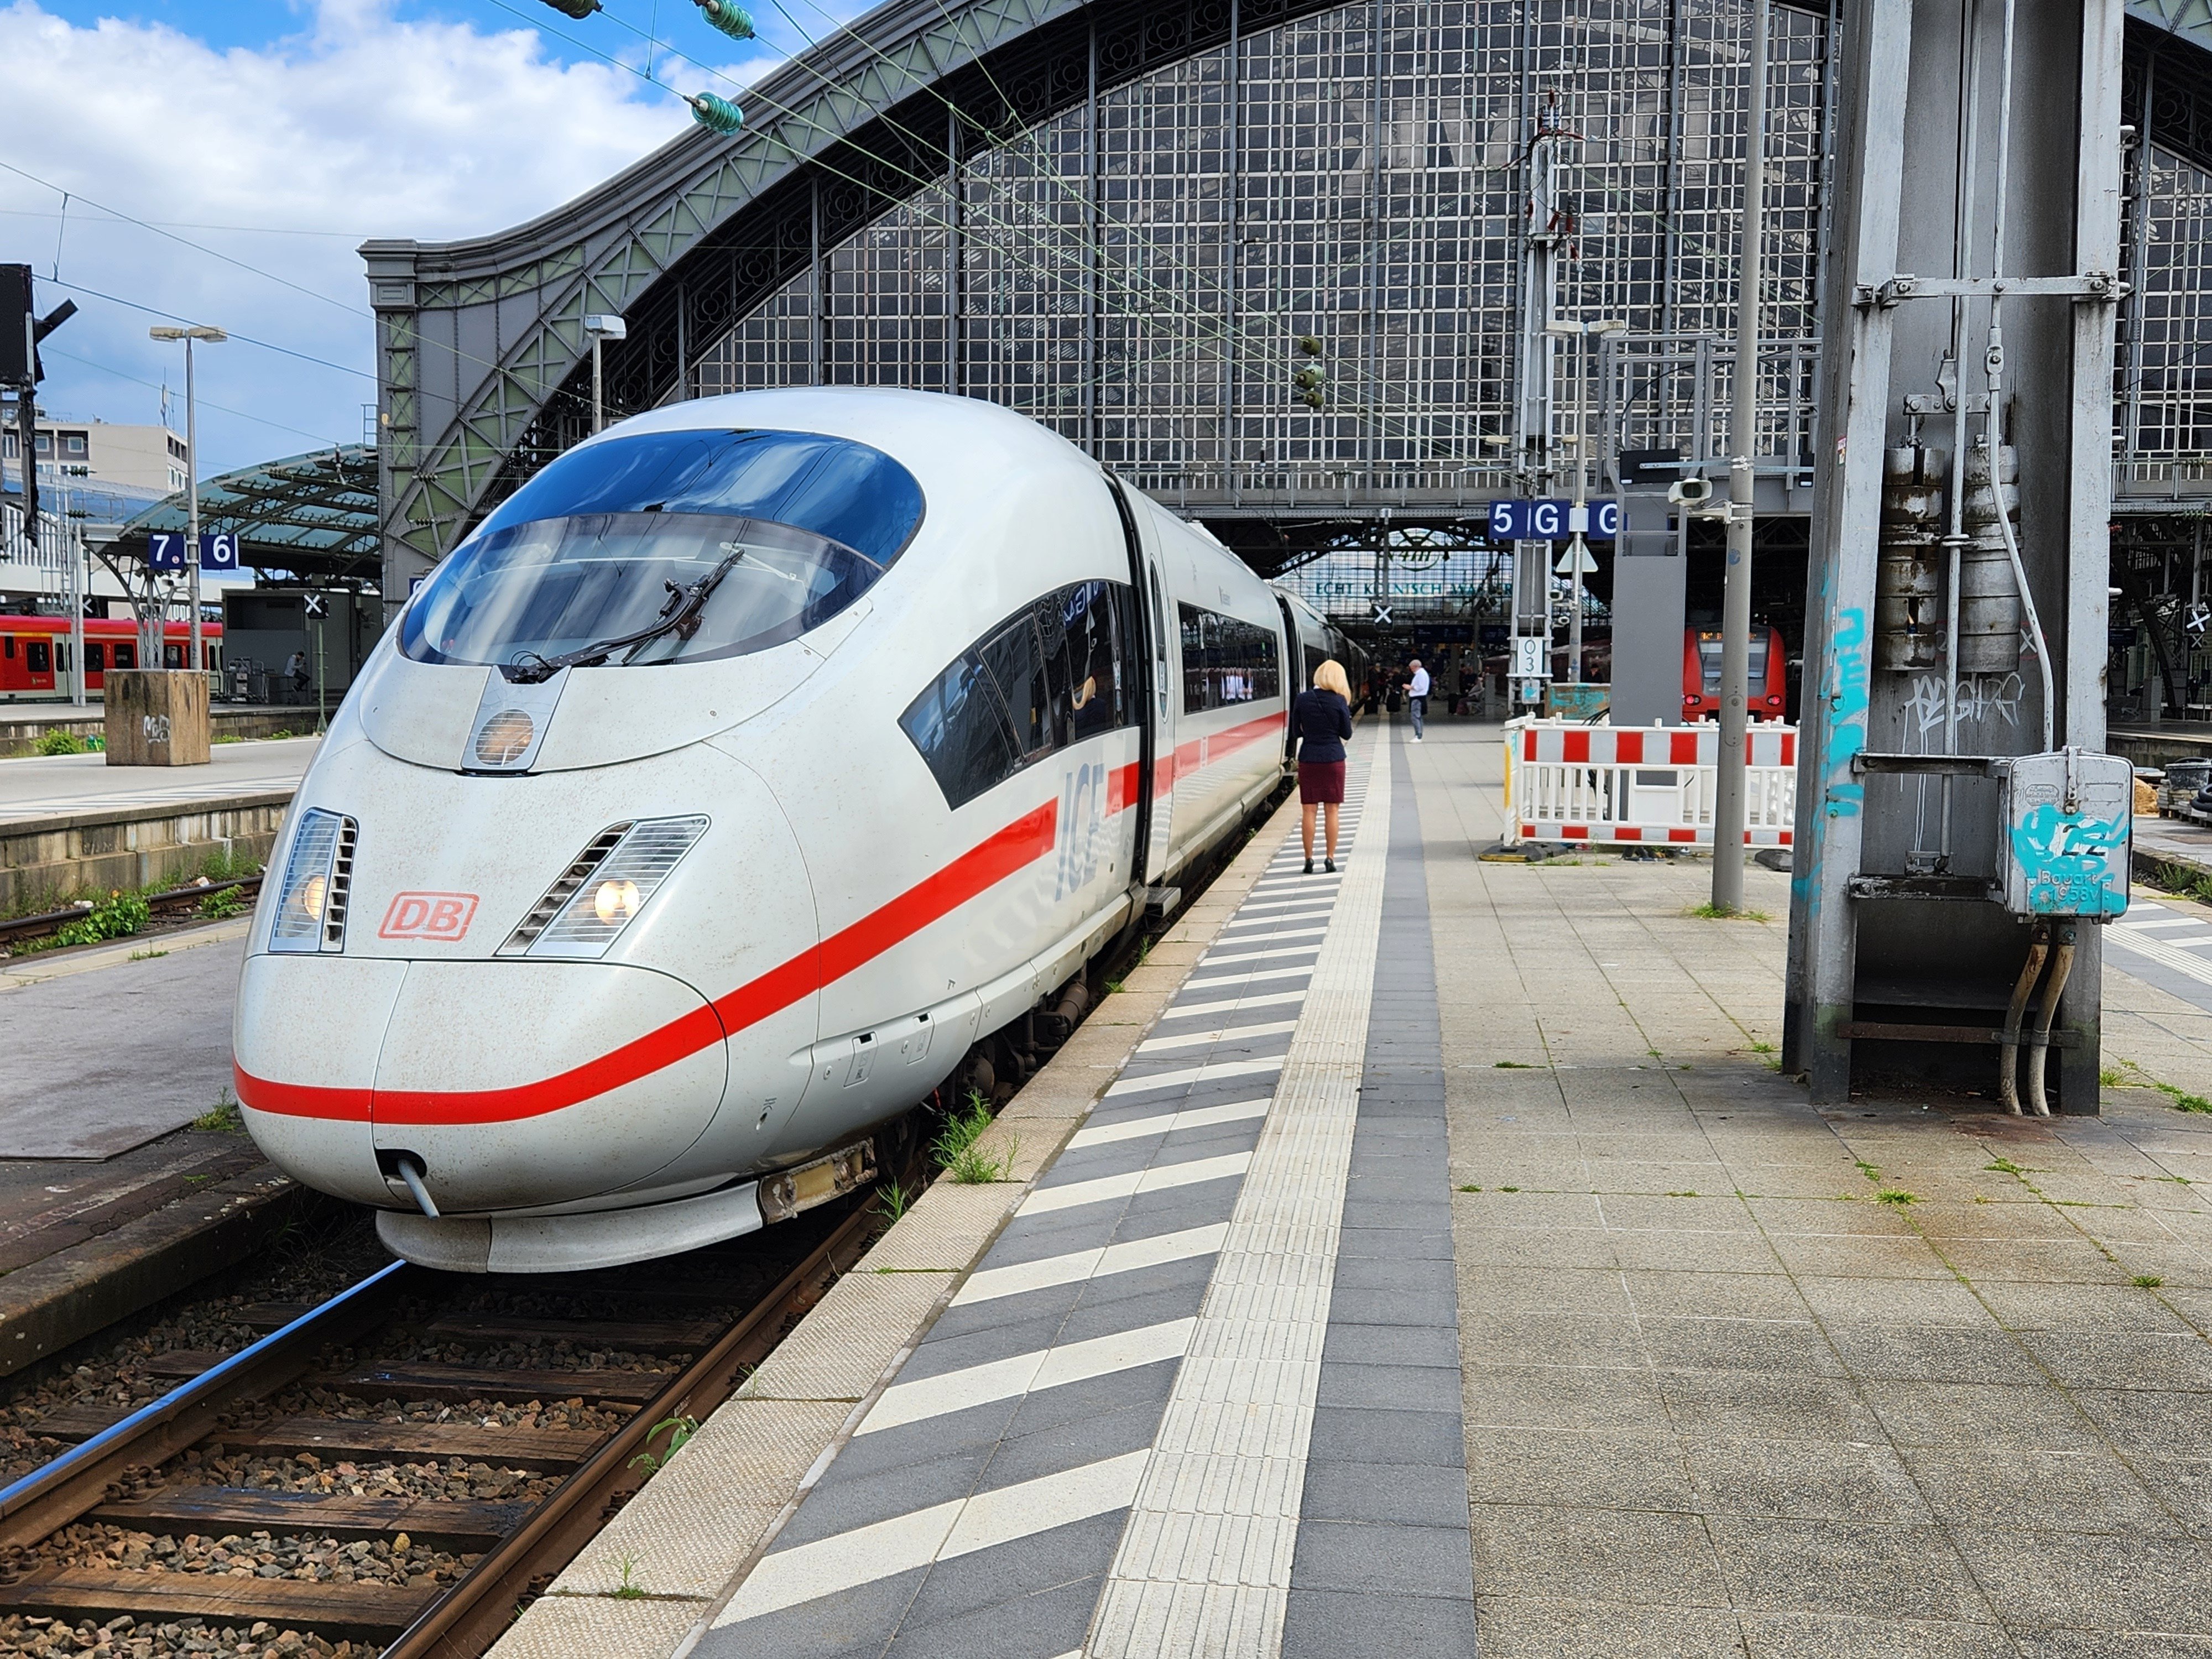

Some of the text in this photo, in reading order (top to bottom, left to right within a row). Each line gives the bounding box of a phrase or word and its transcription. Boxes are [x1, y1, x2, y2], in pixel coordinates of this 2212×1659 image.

[1494, 504, 1558, 534] 5 G
[153, 534, 231, 562] 7 6
[1316, 583, 1352, 594] ECHT
[1056, 763, 1103, 902] ICE
[390, 899, 464, 932] DB
